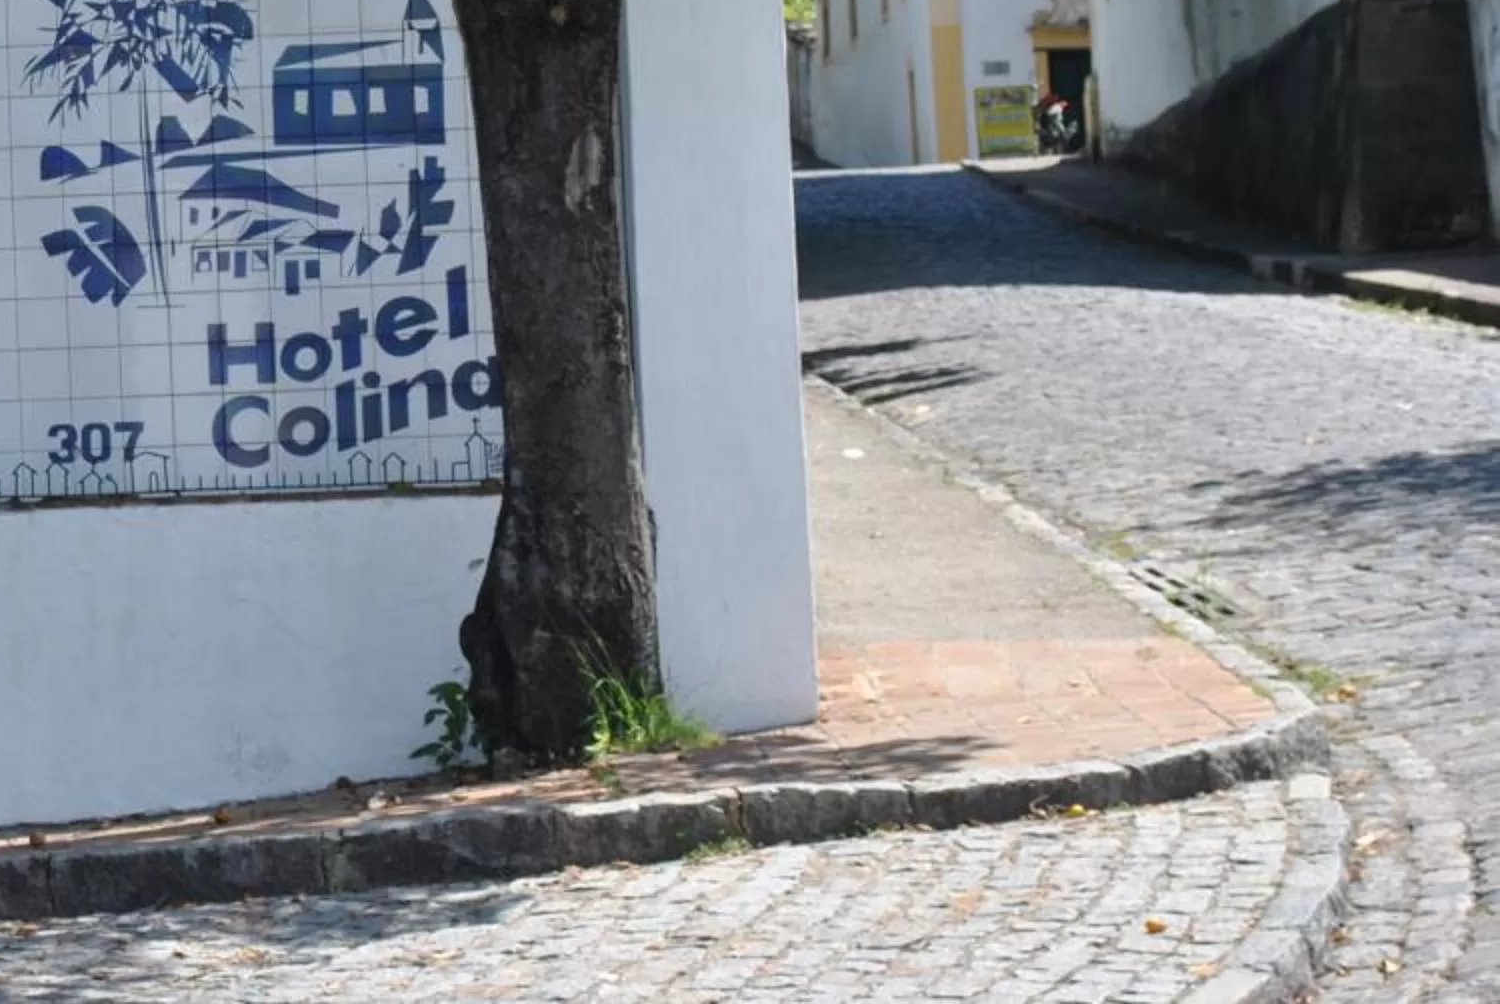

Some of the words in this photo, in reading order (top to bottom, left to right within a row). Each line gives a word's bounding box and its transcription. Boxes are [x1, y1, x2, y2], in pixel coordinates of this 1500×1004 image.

[207, 265, 470, 385] Hotel
[47, 422, 145, 465] 307
[212, 355, 503, 469] Colina
